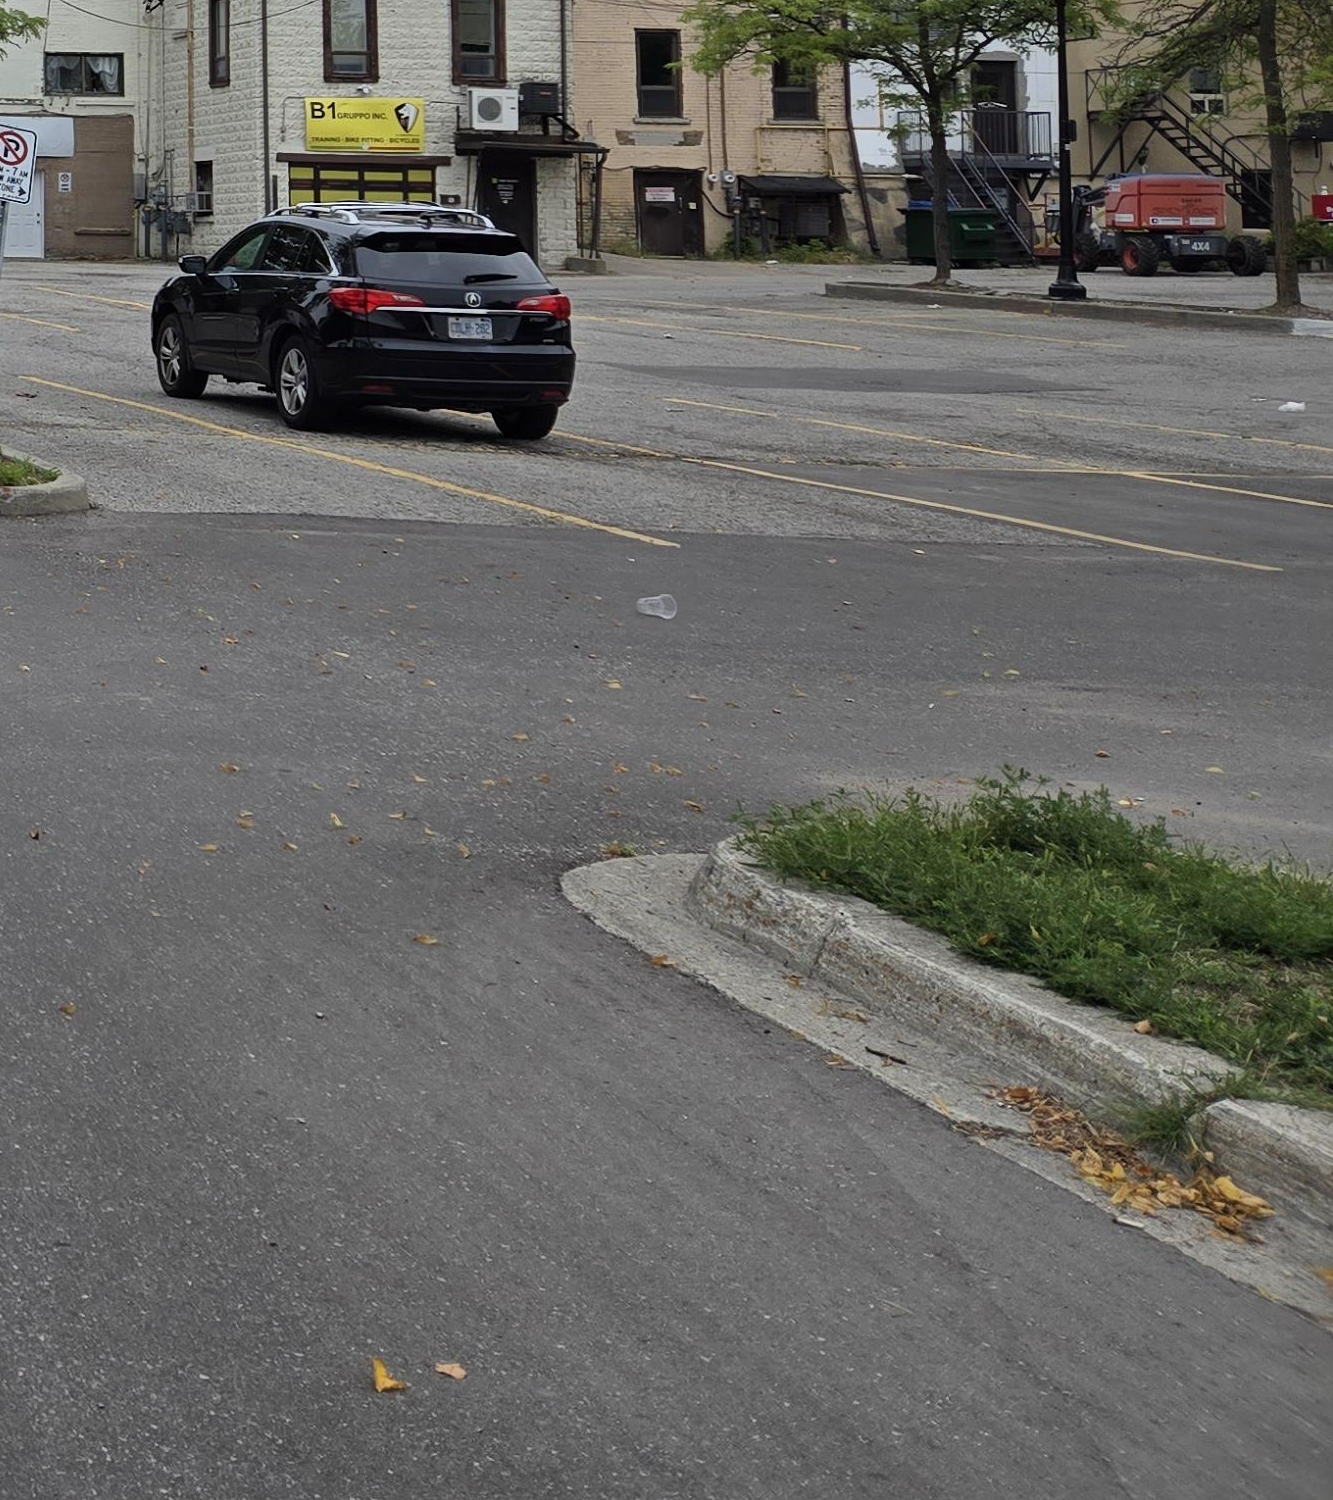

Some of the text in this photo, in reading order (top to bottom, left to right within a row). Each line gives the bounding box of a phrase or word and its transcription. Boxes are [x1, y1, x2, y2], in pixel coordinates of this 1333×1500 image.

[310, 101, 336, 119] B1
[12, 166, 19, 176] 7
[19, 170, 29, 178] AM
[6, 176, 24, 186] AWAY
[1191, 241, 1210, 251] 4X4
